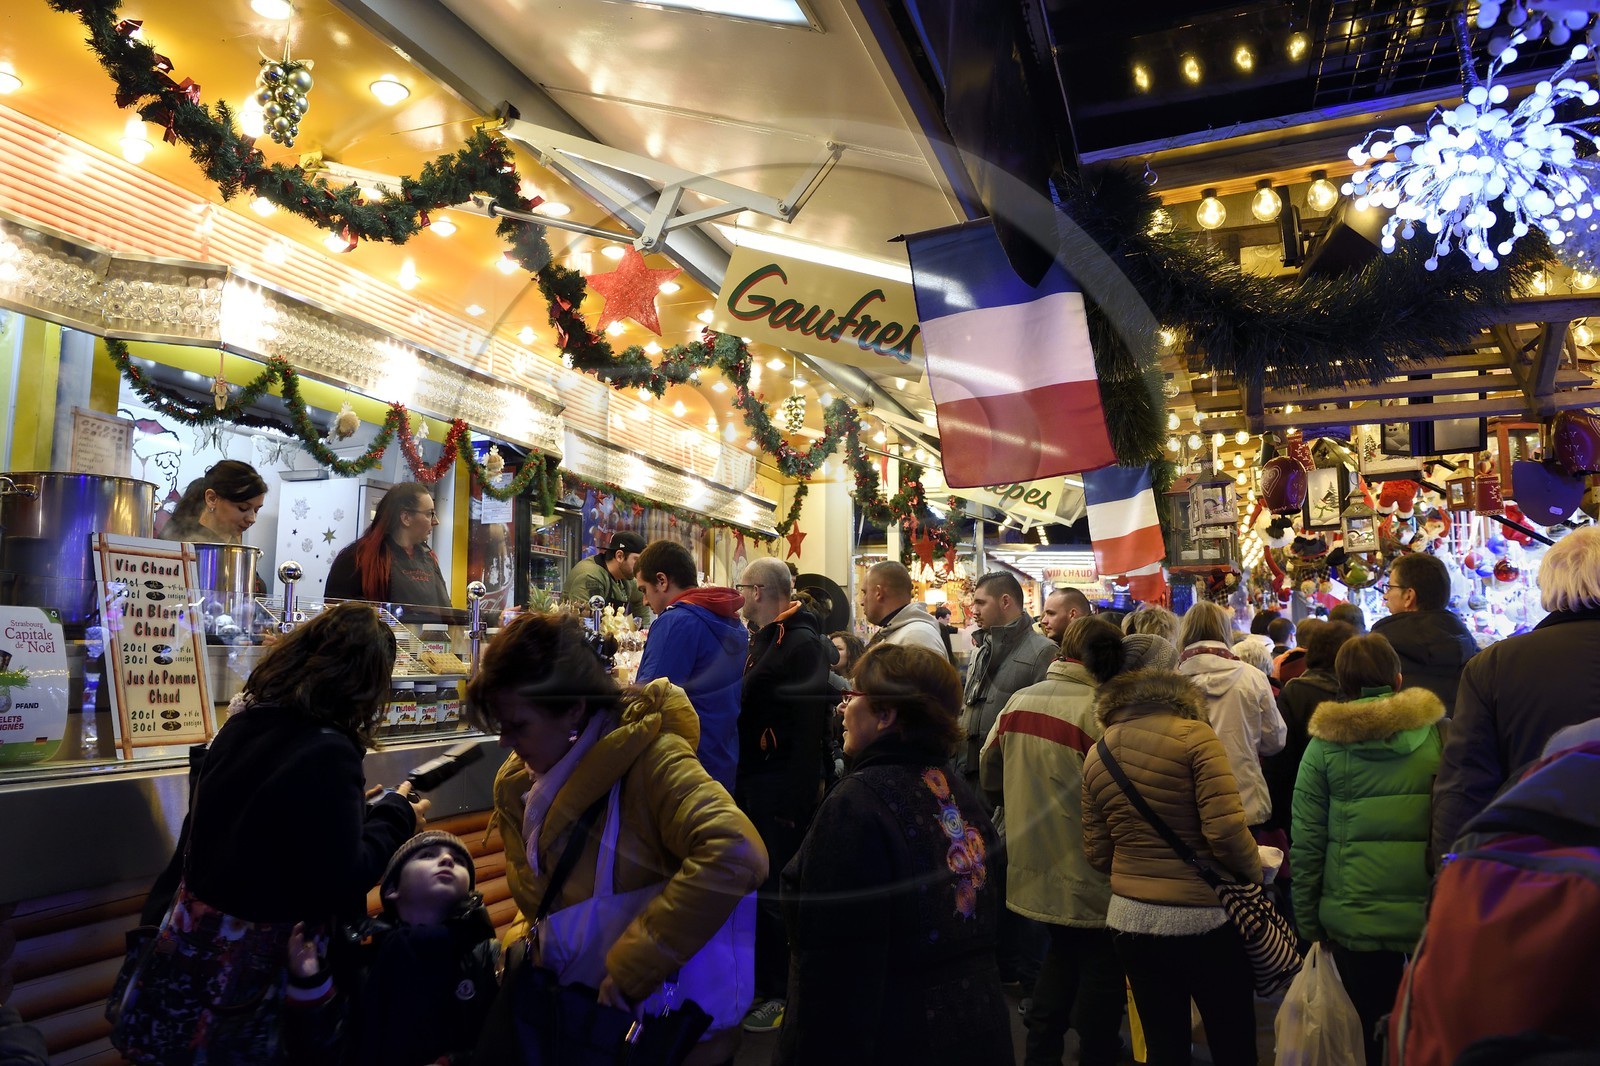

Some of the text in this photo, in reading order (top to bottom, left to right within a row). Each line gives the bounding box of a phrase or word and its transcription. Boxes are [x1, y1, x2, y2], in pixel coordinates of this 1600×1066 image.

[727, 264, 920, 364] Gaufres
[115, 559, 180, 577] Vin Chaud
[1063, 569, 1093, 578] CHAUD
[121, 602, 143, 617] Vin
[10, 619, 44, 628] Strasbourg
[134, 622, 176, 637] Chaud
[5, 627, 53, 642] Capitale
[15, 641, 56, 653] de Noël
[123, 643, 146, 653] 20cl
[124, 655, 148, 665] 30cl
[126, 669, 197, 686] Jus de Pomme
[149, 689, 181, 704] Chaud
[15, 702, 39, 710] PFAND
[131, 710, 154, 720] 20cl
[132, 722, 156, 732] 30cl
